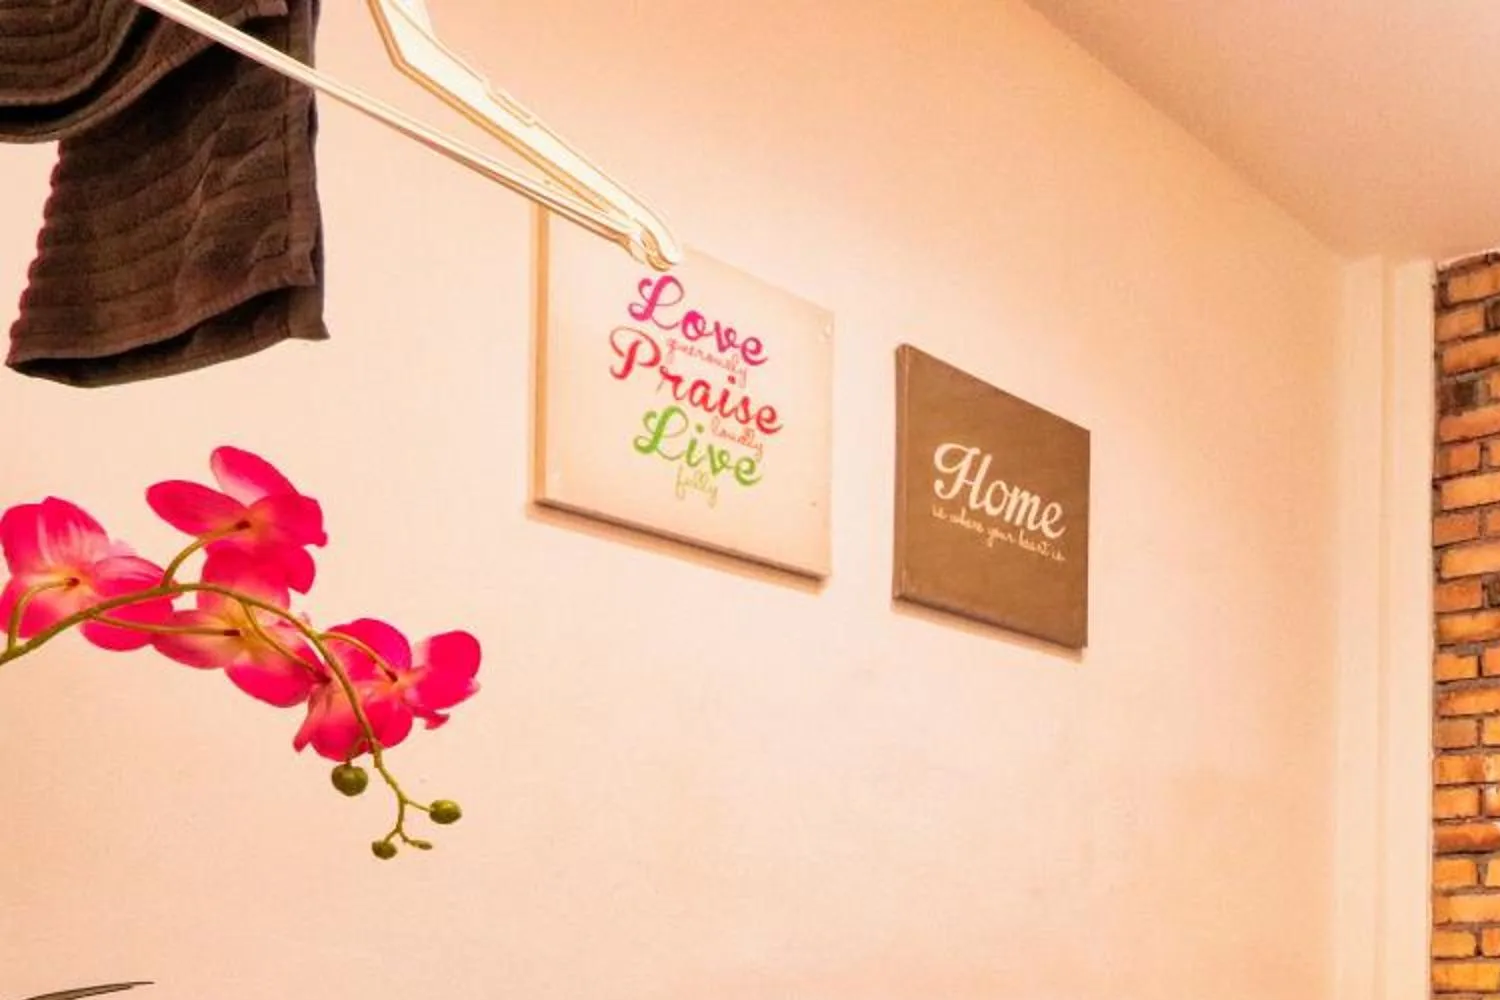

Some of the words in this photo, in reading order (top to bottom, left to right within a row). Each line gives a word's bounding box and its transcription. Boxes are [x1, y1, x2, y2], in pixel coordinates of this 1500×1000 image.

[628, 275, 768, 366] Love
[609, 326, 783, 434] Praise
[633, 406, 762, 486] Live
[933, 442, 1066, 539] Home
